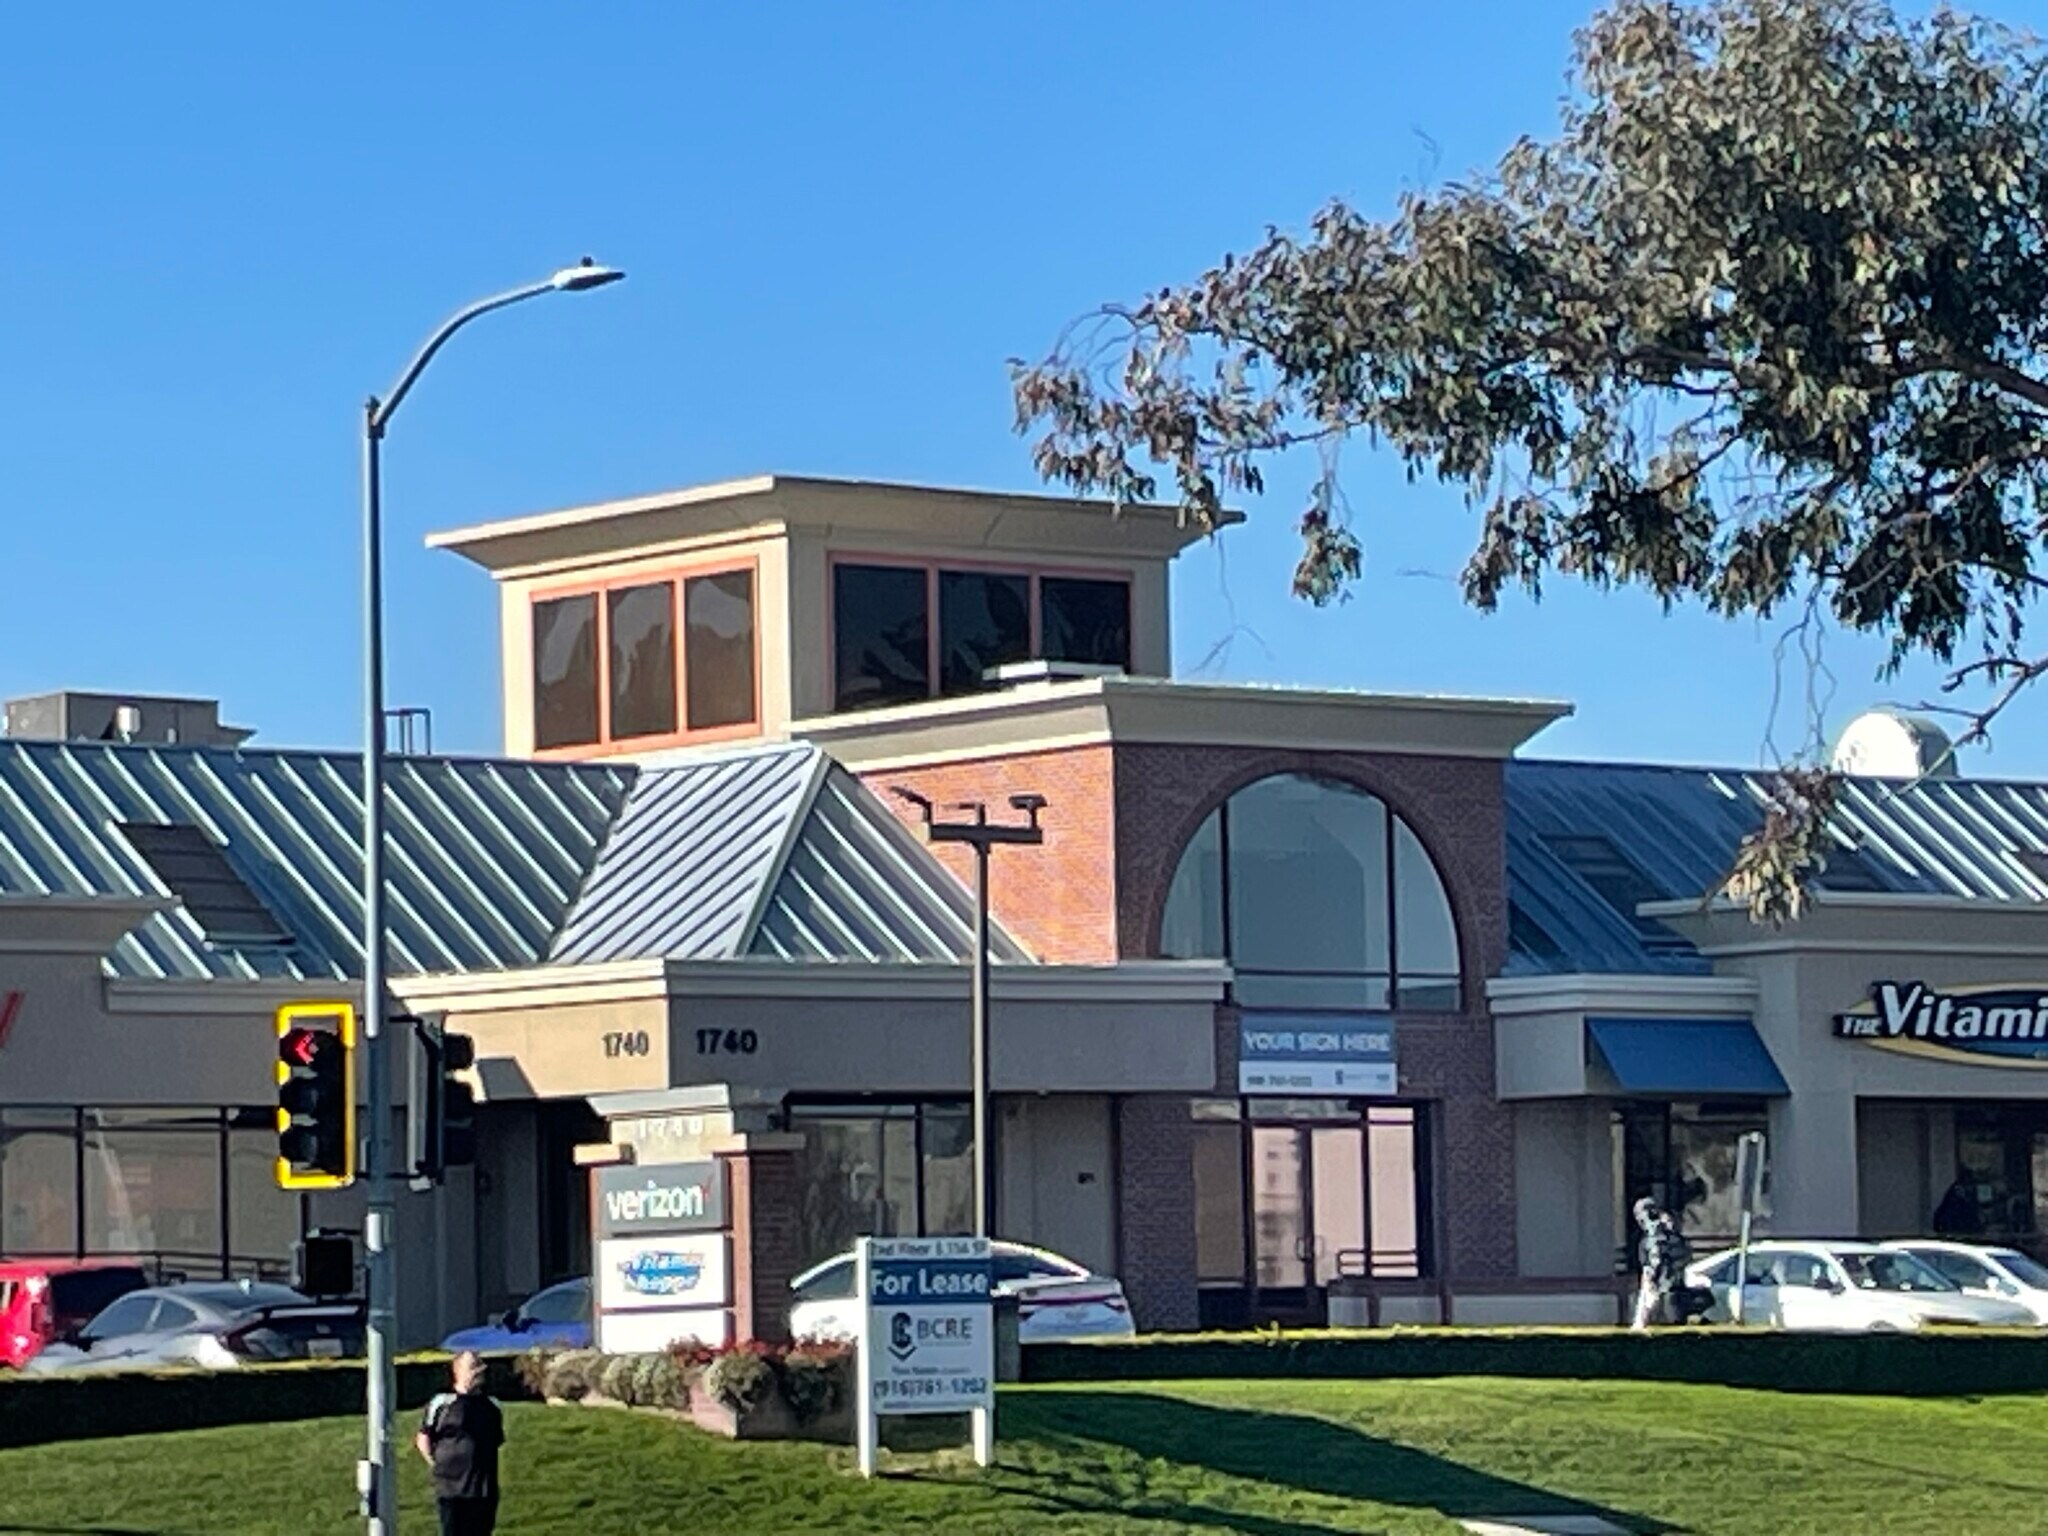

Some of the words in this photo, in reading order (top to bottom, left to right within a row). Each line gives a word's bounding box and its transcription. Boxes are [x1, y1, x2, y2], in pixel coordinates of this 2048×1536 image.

[602, 1030, 649, 1058] 1740
[696, 1027, 758, 1055] 1740
[1243, 1031, 1295, 1051] YOUR
[1299, 1031, 1341, 1052] SIGN
[1343, 1032, 1391, 1052] HERE
[606, 1179, 704, 1220] verizon
[871, 1268, 913, 1296] For
[918, 1267, 988, 1296] Lease
